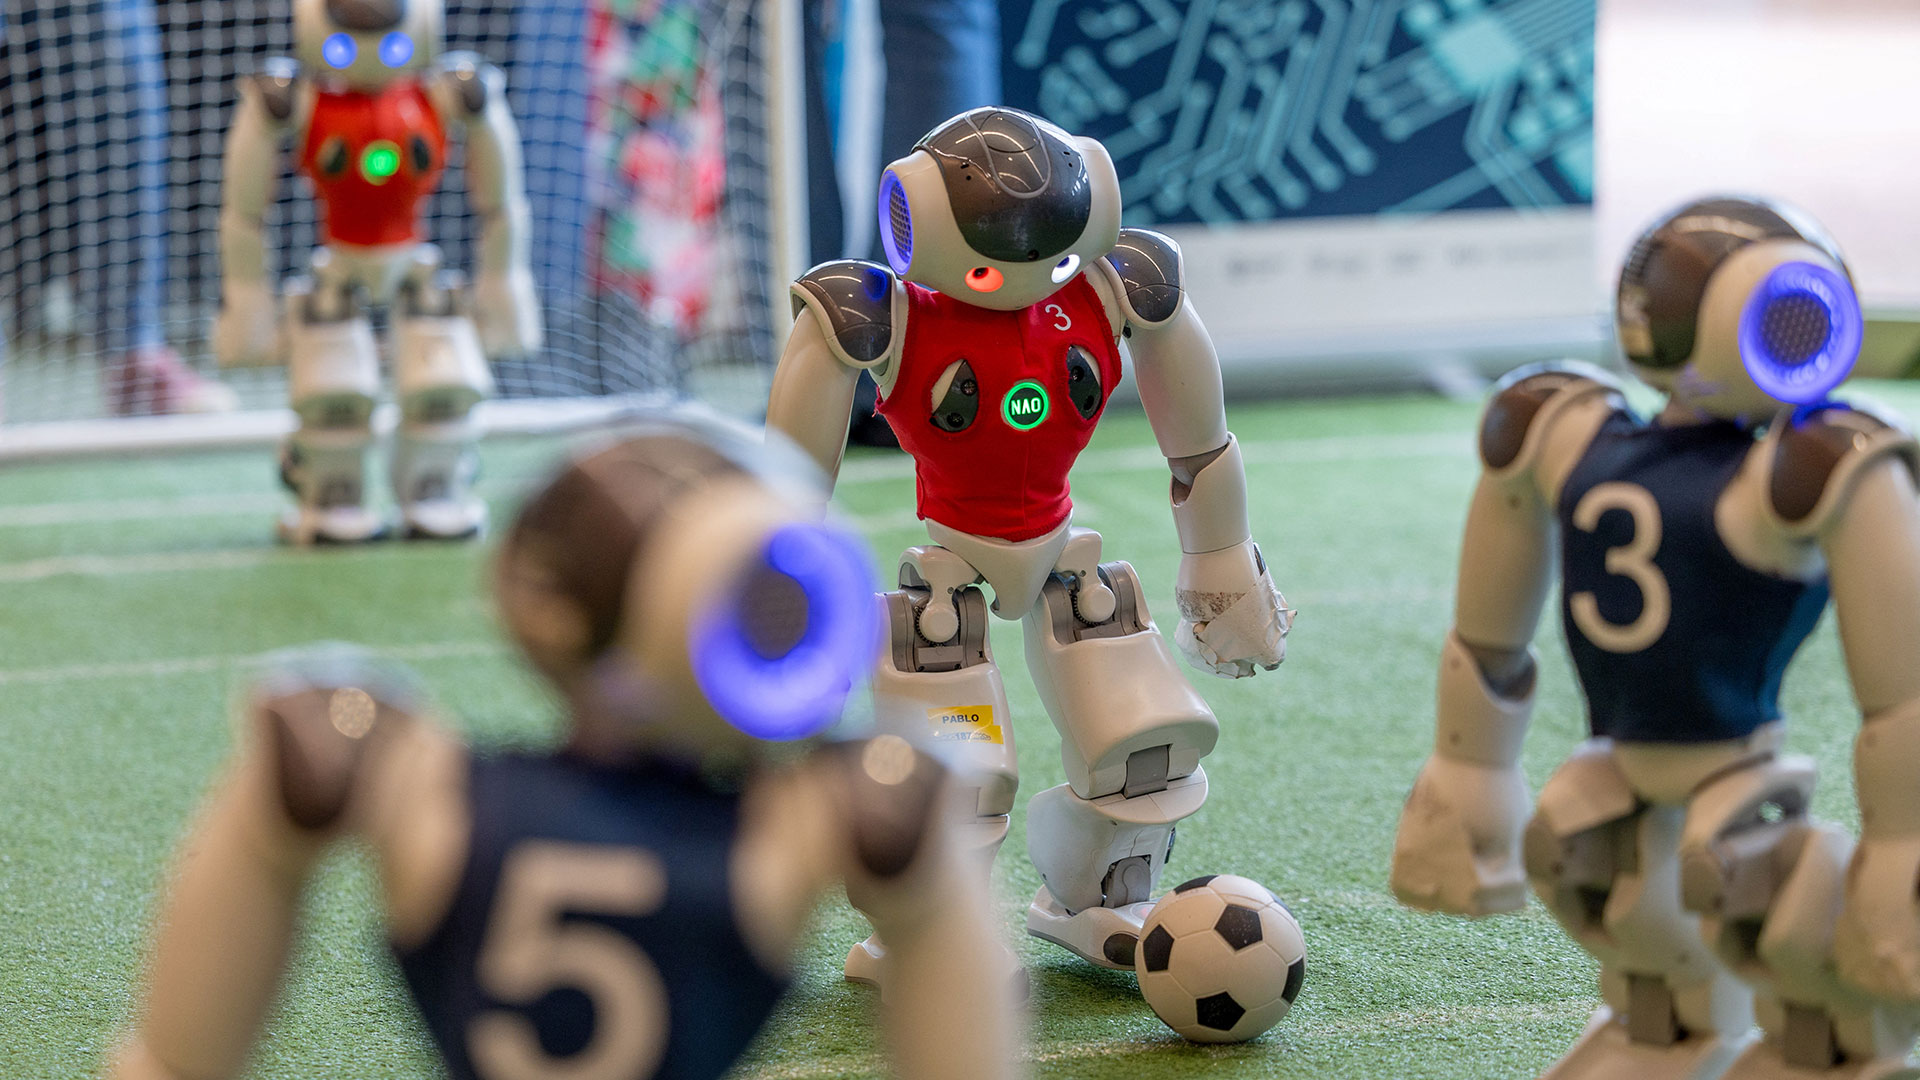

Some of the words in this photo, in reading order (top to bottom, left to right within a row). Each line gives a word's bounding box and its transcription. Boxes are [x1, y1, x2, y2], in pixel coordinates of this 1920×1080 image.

[1044, 303, 1072, 332] 3
[1011, 397, 1042, 416] NAO
[1569, 480, 1673, 655] 3
[942, 713, 980, 724] PABLO
[465, 838, 672, 1080] 5
